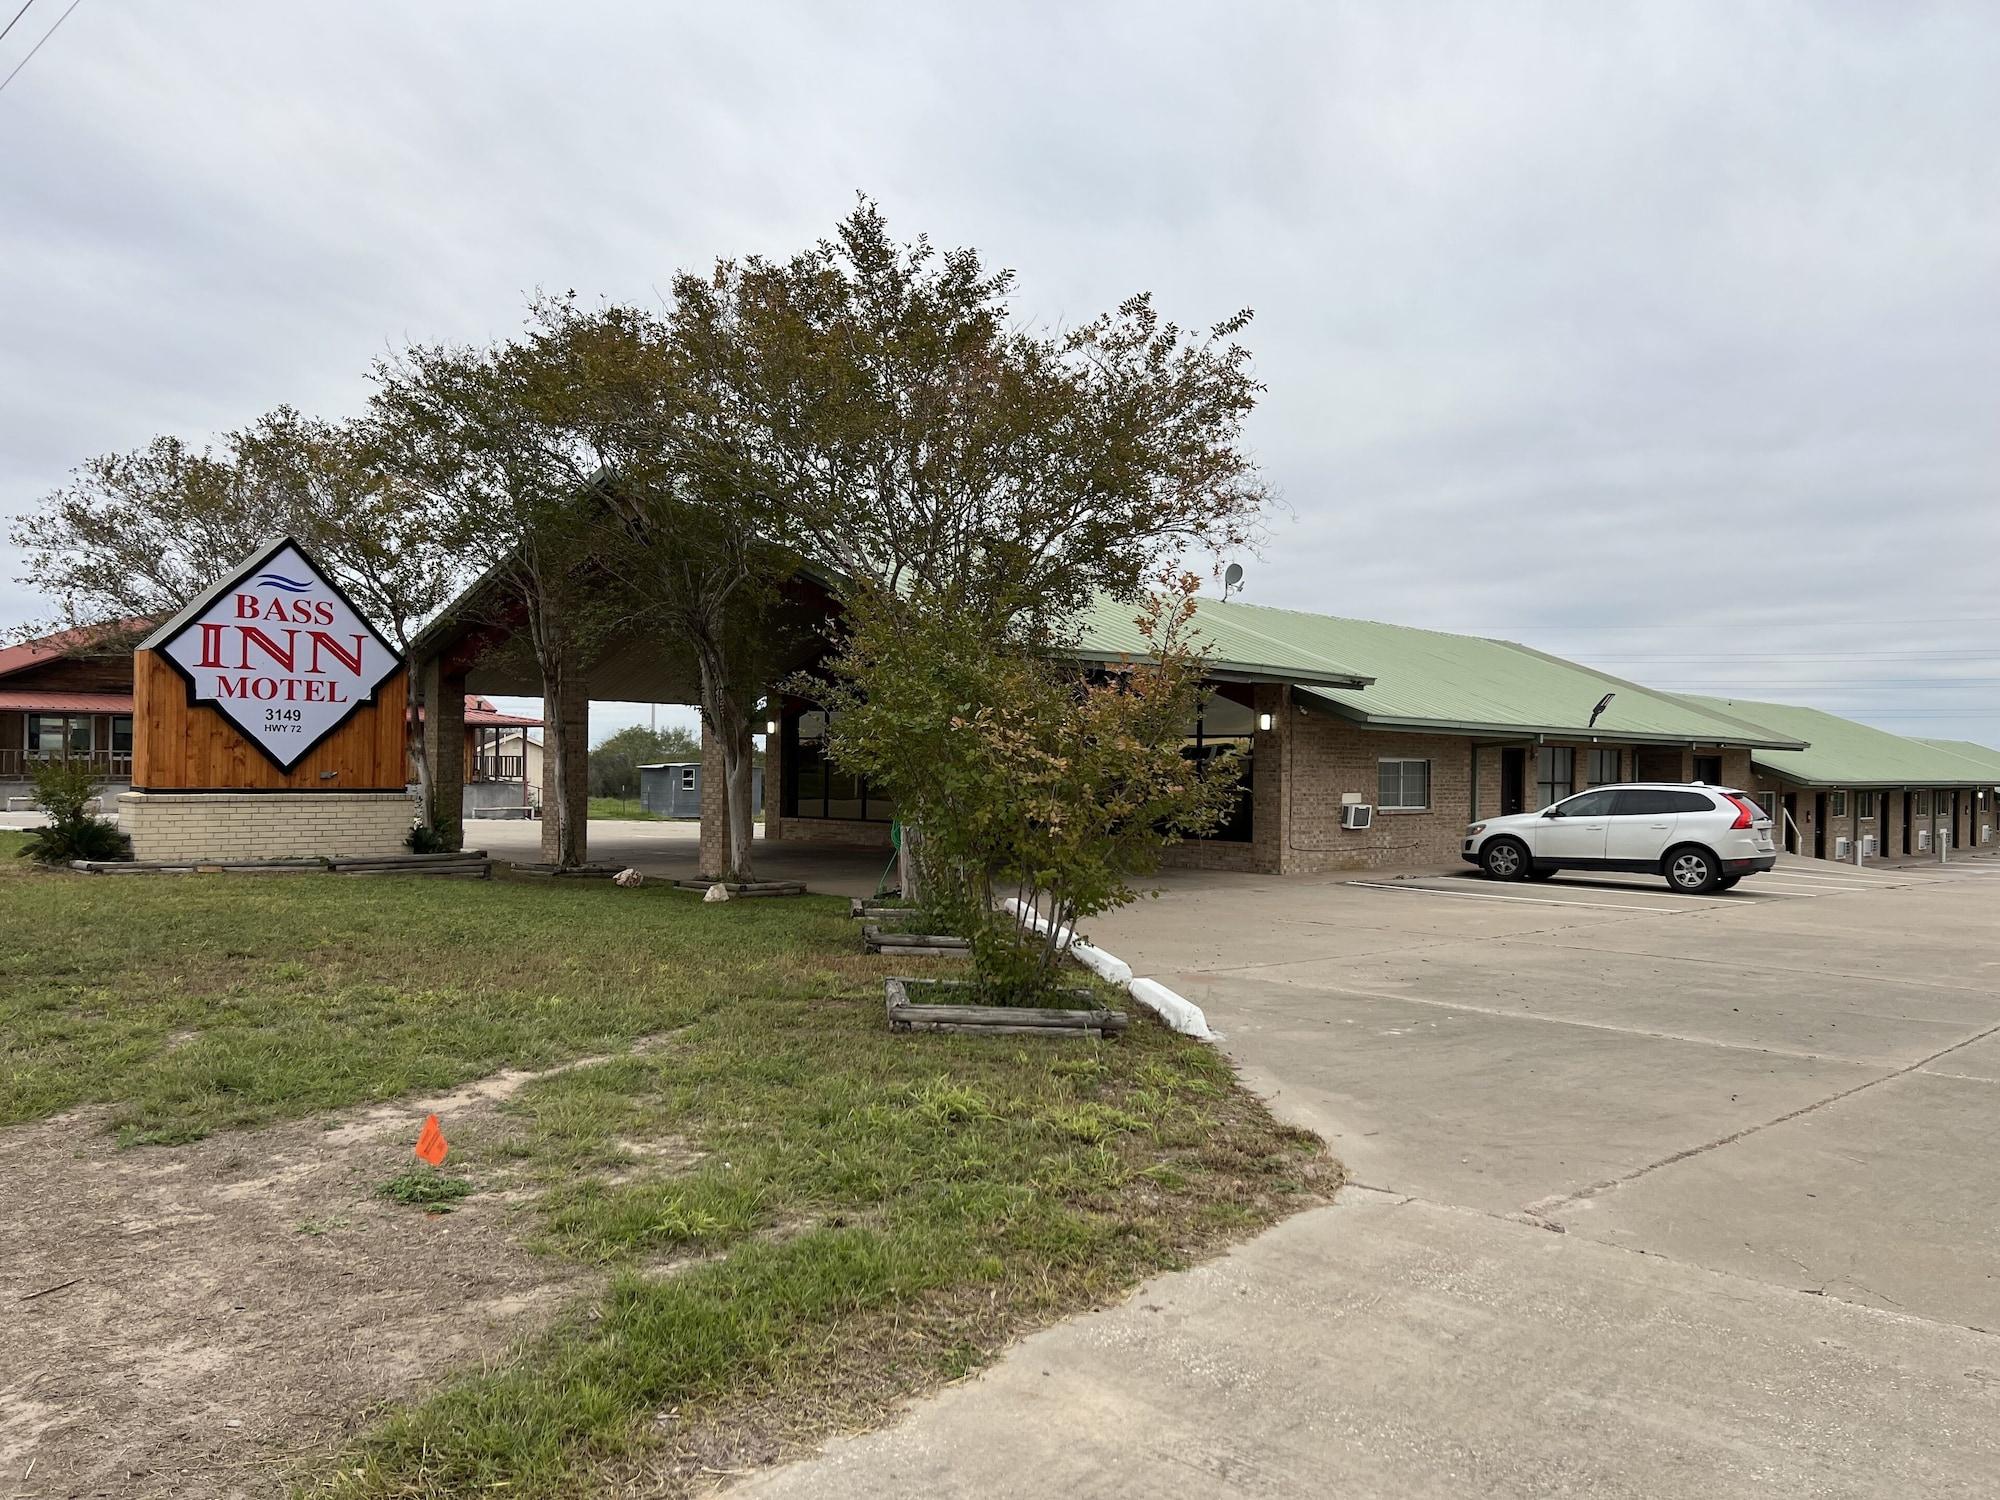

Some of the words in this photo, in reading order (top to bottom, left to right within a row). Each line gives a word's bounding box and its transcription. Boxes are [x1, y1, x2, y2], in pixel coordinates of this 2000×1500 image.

[234, 593, 334, 625] BASS
[193, 623, 369, 677] INN
[215, 675, 348, 703] MOTEL
[264, 724, 288, 733] HWY
[290, 724, 302, 733] 72
[265, 708, 301, 721] 3149
